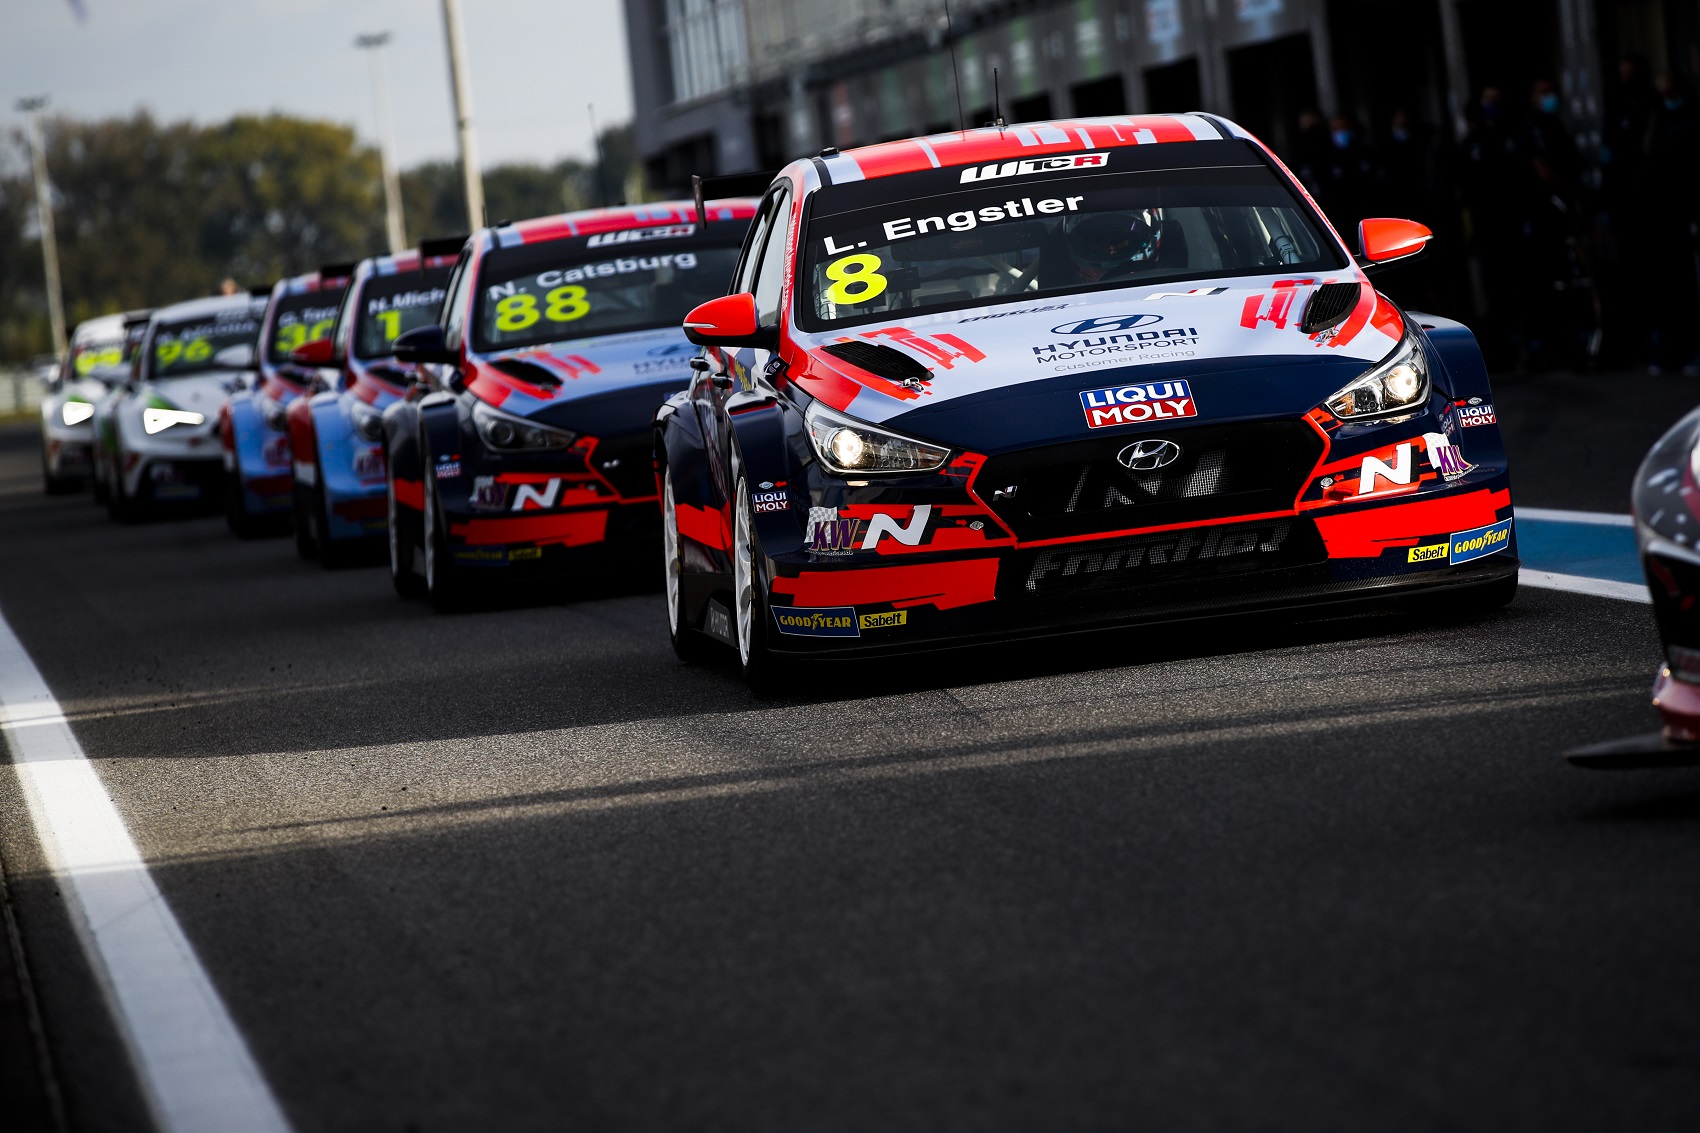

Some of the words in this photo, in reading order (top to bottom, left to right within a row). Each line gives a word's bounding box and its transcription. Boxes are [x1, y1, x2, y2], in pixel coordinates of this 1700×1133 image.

[960, 152, 1110, 184] WTCR
[823, 235, 868, 256] L.
[882, 195, 1084, 241] Engstler
[489, 281, 528, 301] N.
[536, 253, 699, 288] Catsburg
[825, 253, 888, 305] 8
[495, 285, 591, 332] 88
[376, 310, 399, 341] 1
[1032, 327, 1200, 354] HYUNDAI
[1036, 337, 1199, 364] MOTORSPORT
[1054, 355, 1132, 372] Customer
[1138, 349, 1195, 363] Racing
[1086, 382, 1185, 407] LIQUI
[1092, 399, 1189, 426] MOLY
[1459, 405, 1493, 418] LIQUI
[1462, 414, 1495, 427] MOLY
[754, 492, 787, 503] LIQUI
[755, 500, 788, 512] MOLY
[810, 519, 861, 552] KW
[1412, 545, 1444, 560] Sabelt
[864, 612, 902, 627] Sabelt
